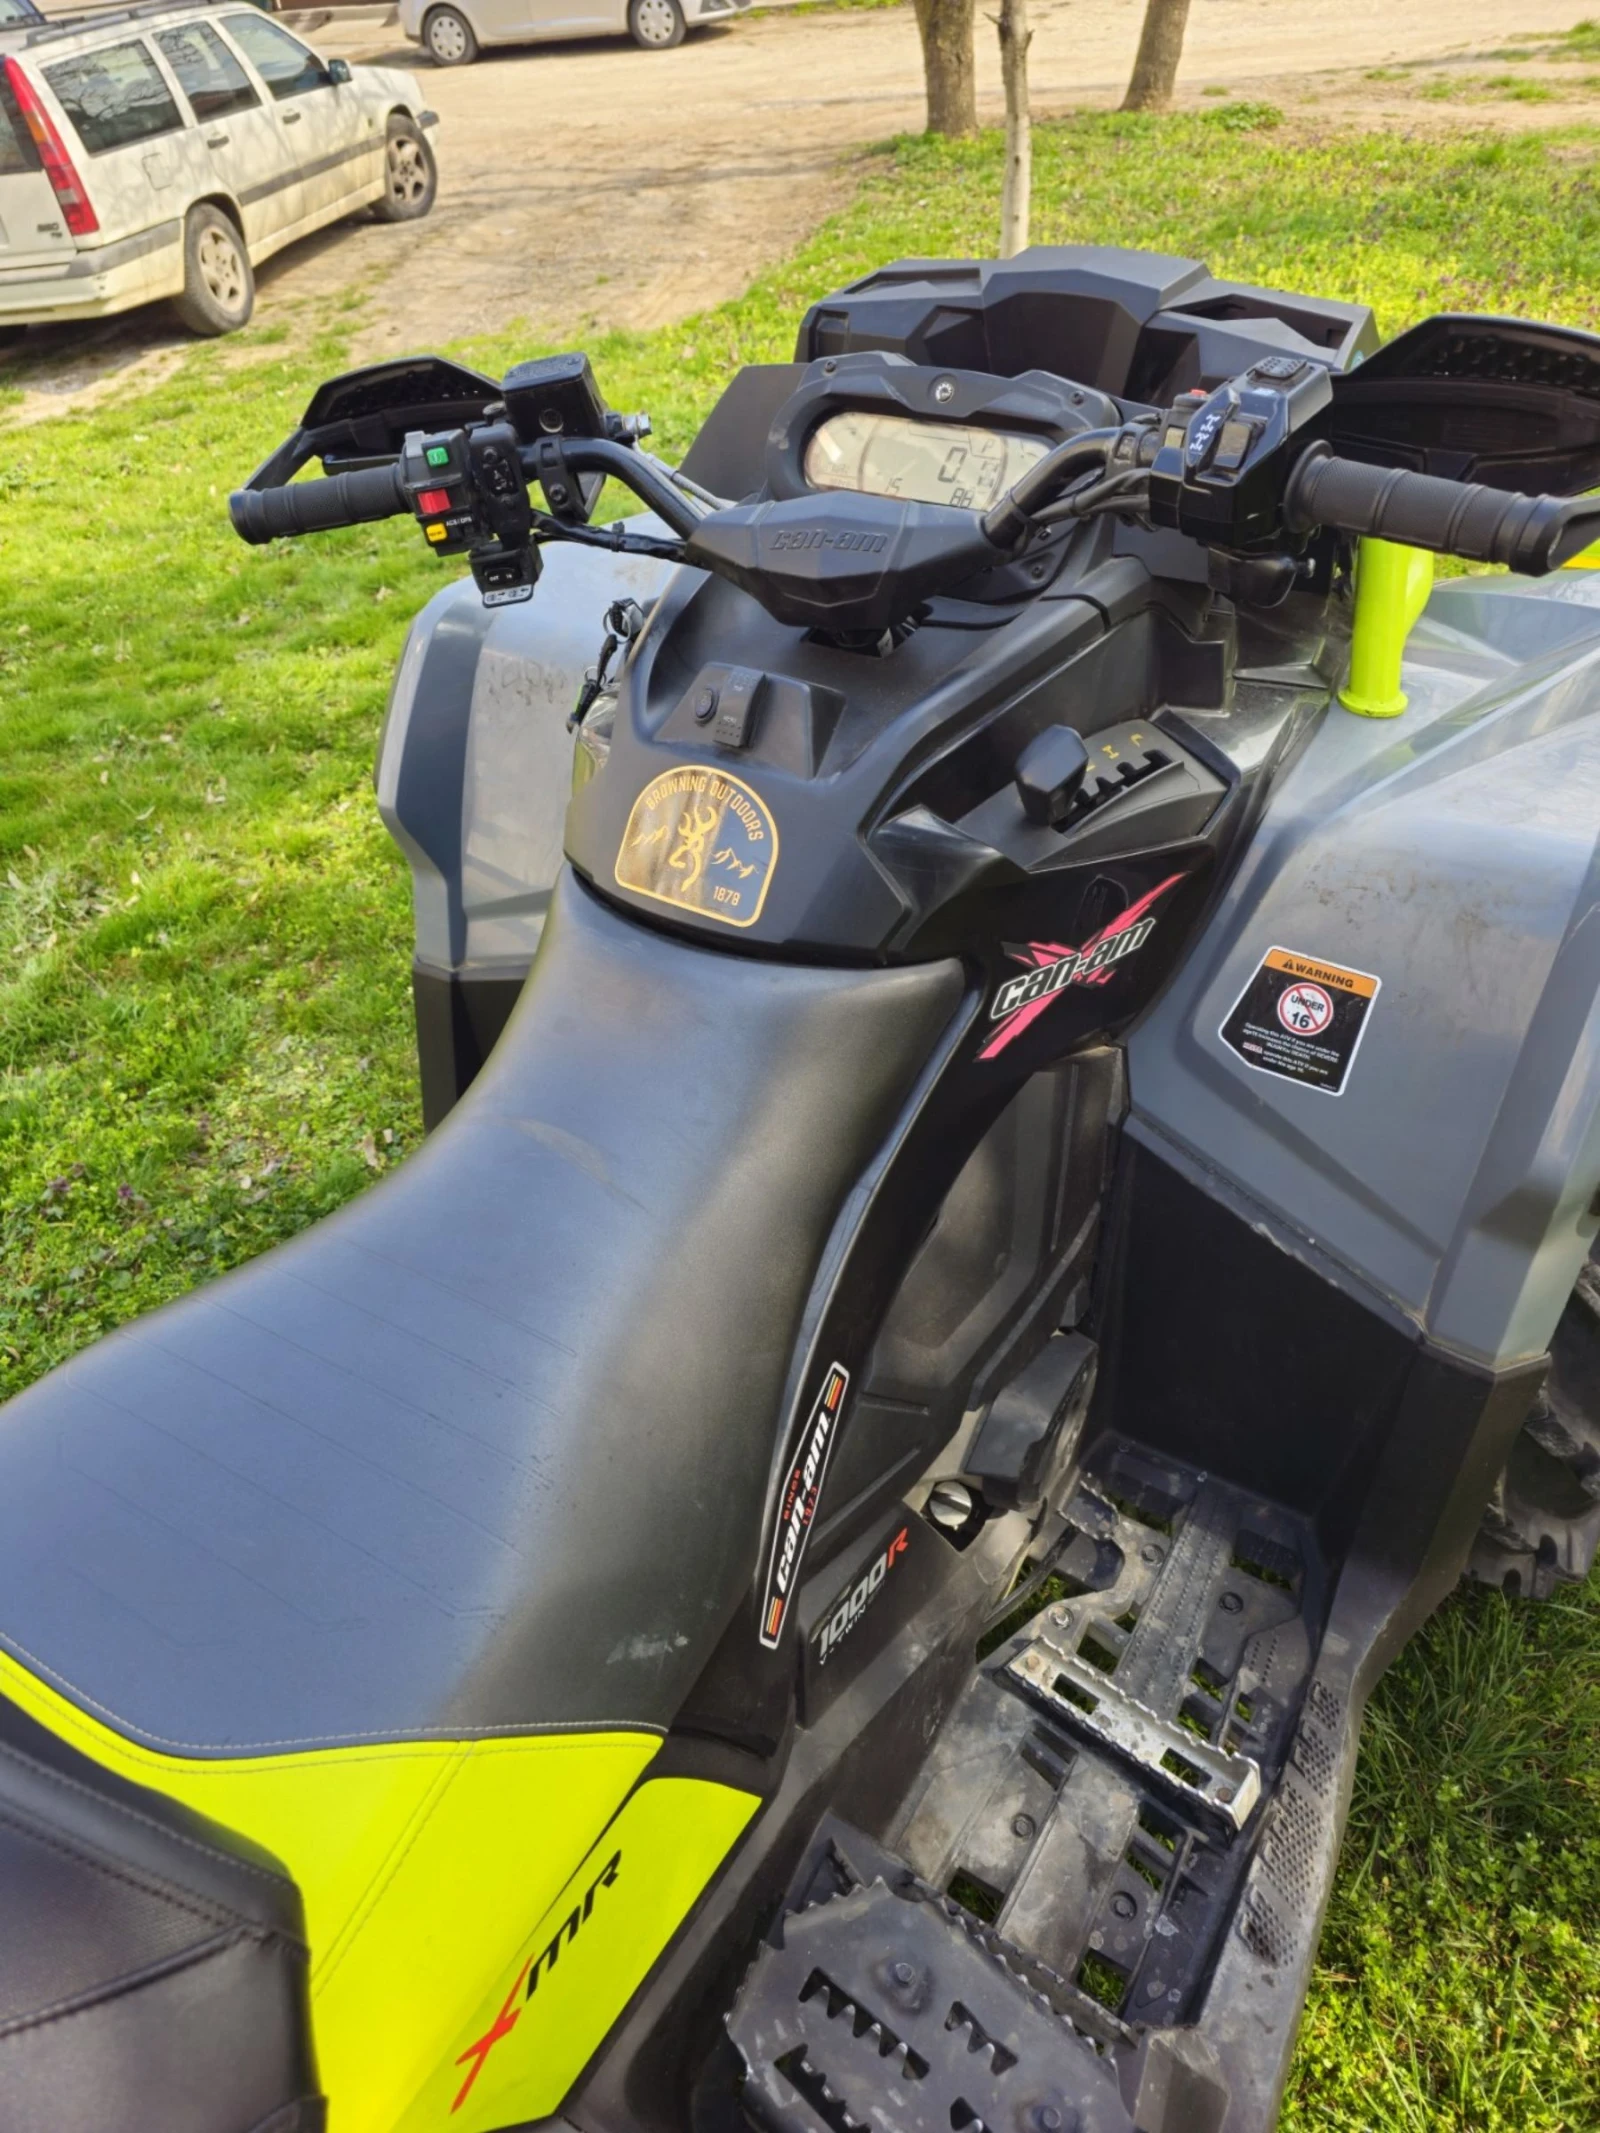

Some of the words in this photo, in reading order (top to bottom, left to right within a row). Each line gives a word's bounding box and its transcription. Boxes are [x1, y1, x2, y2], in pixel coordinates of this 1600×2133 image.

[644, 775, 706, 811] BROWNING
[709, 780, 764, 841] OUTDOORS
[713, 885, 742, 907] 1878
[1295, 962, 1354, 989] WARNING
[1290, 994, 1325, 1013] UNDER
[1291, 1012, 1311, 1029] 16
